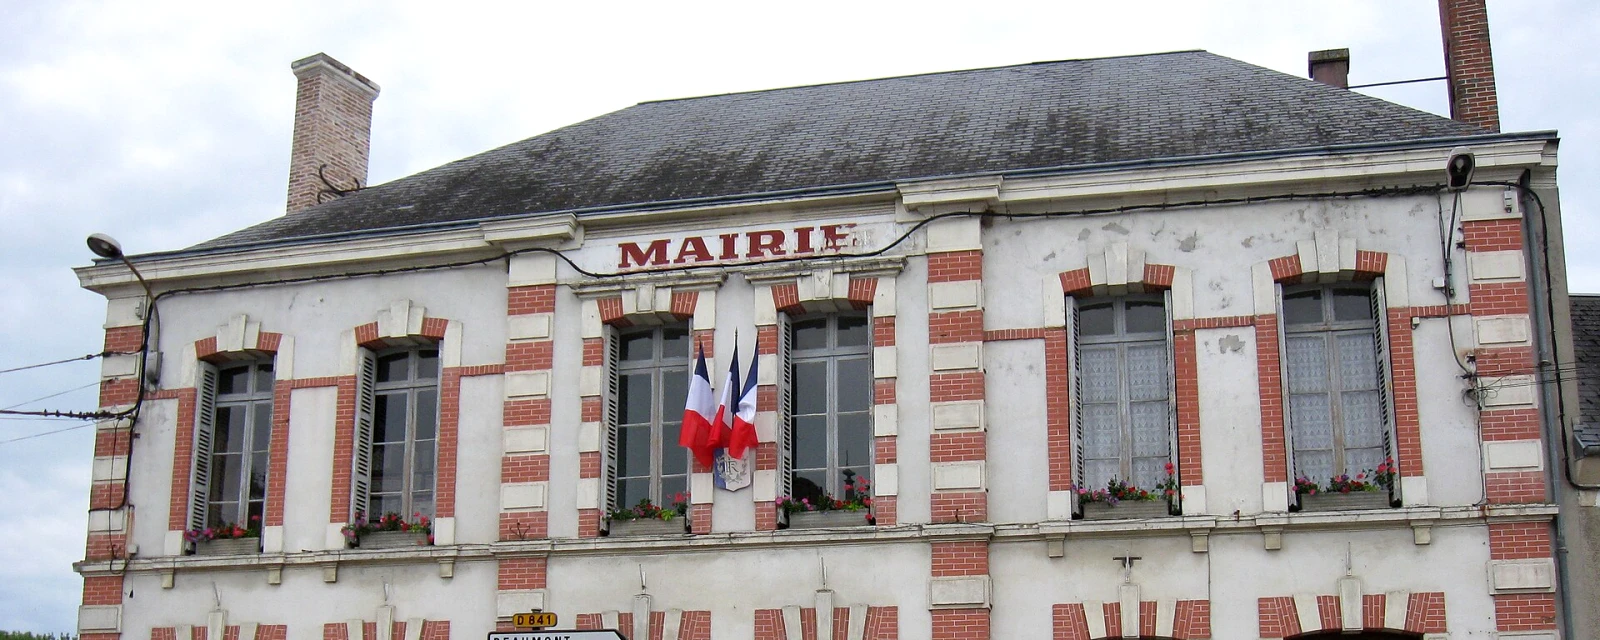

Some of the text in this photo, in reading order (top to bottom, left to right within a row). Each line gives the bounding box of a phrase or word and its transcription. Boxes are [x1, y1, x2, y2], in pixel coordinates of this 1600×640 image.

[618, 223, 857, 268] MAIRIE
[517, 614, 551, 626] D 841
